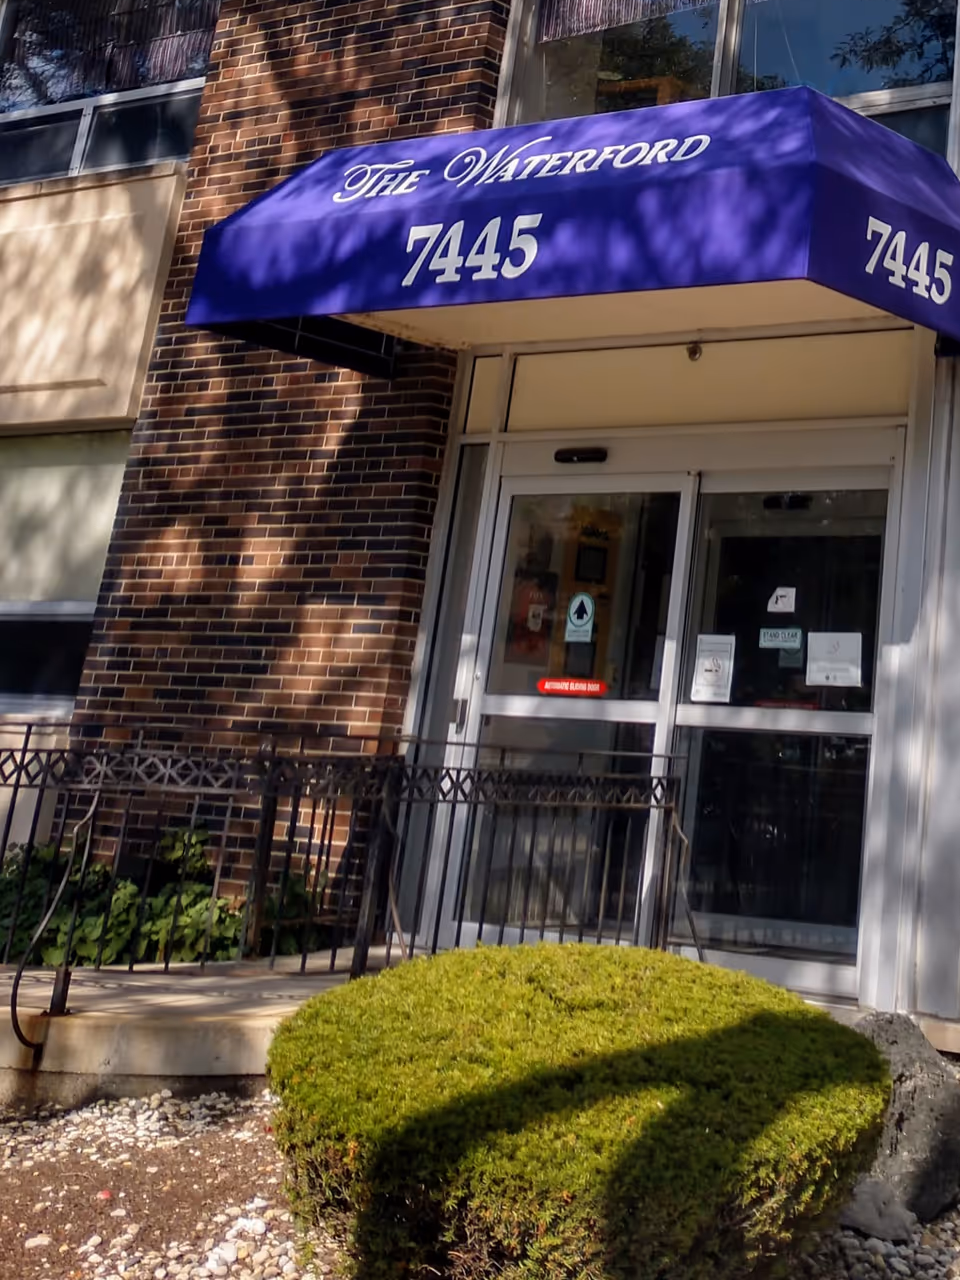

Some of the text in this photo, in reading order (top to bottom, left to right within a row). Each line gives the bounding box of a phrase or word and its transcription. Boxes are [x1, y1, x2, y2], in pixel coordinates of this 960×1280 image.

[444, 135, 711, 188] WATERFORD
[402, 213, 543, 287] 7445
[865, 216, 954, 305] 7445
